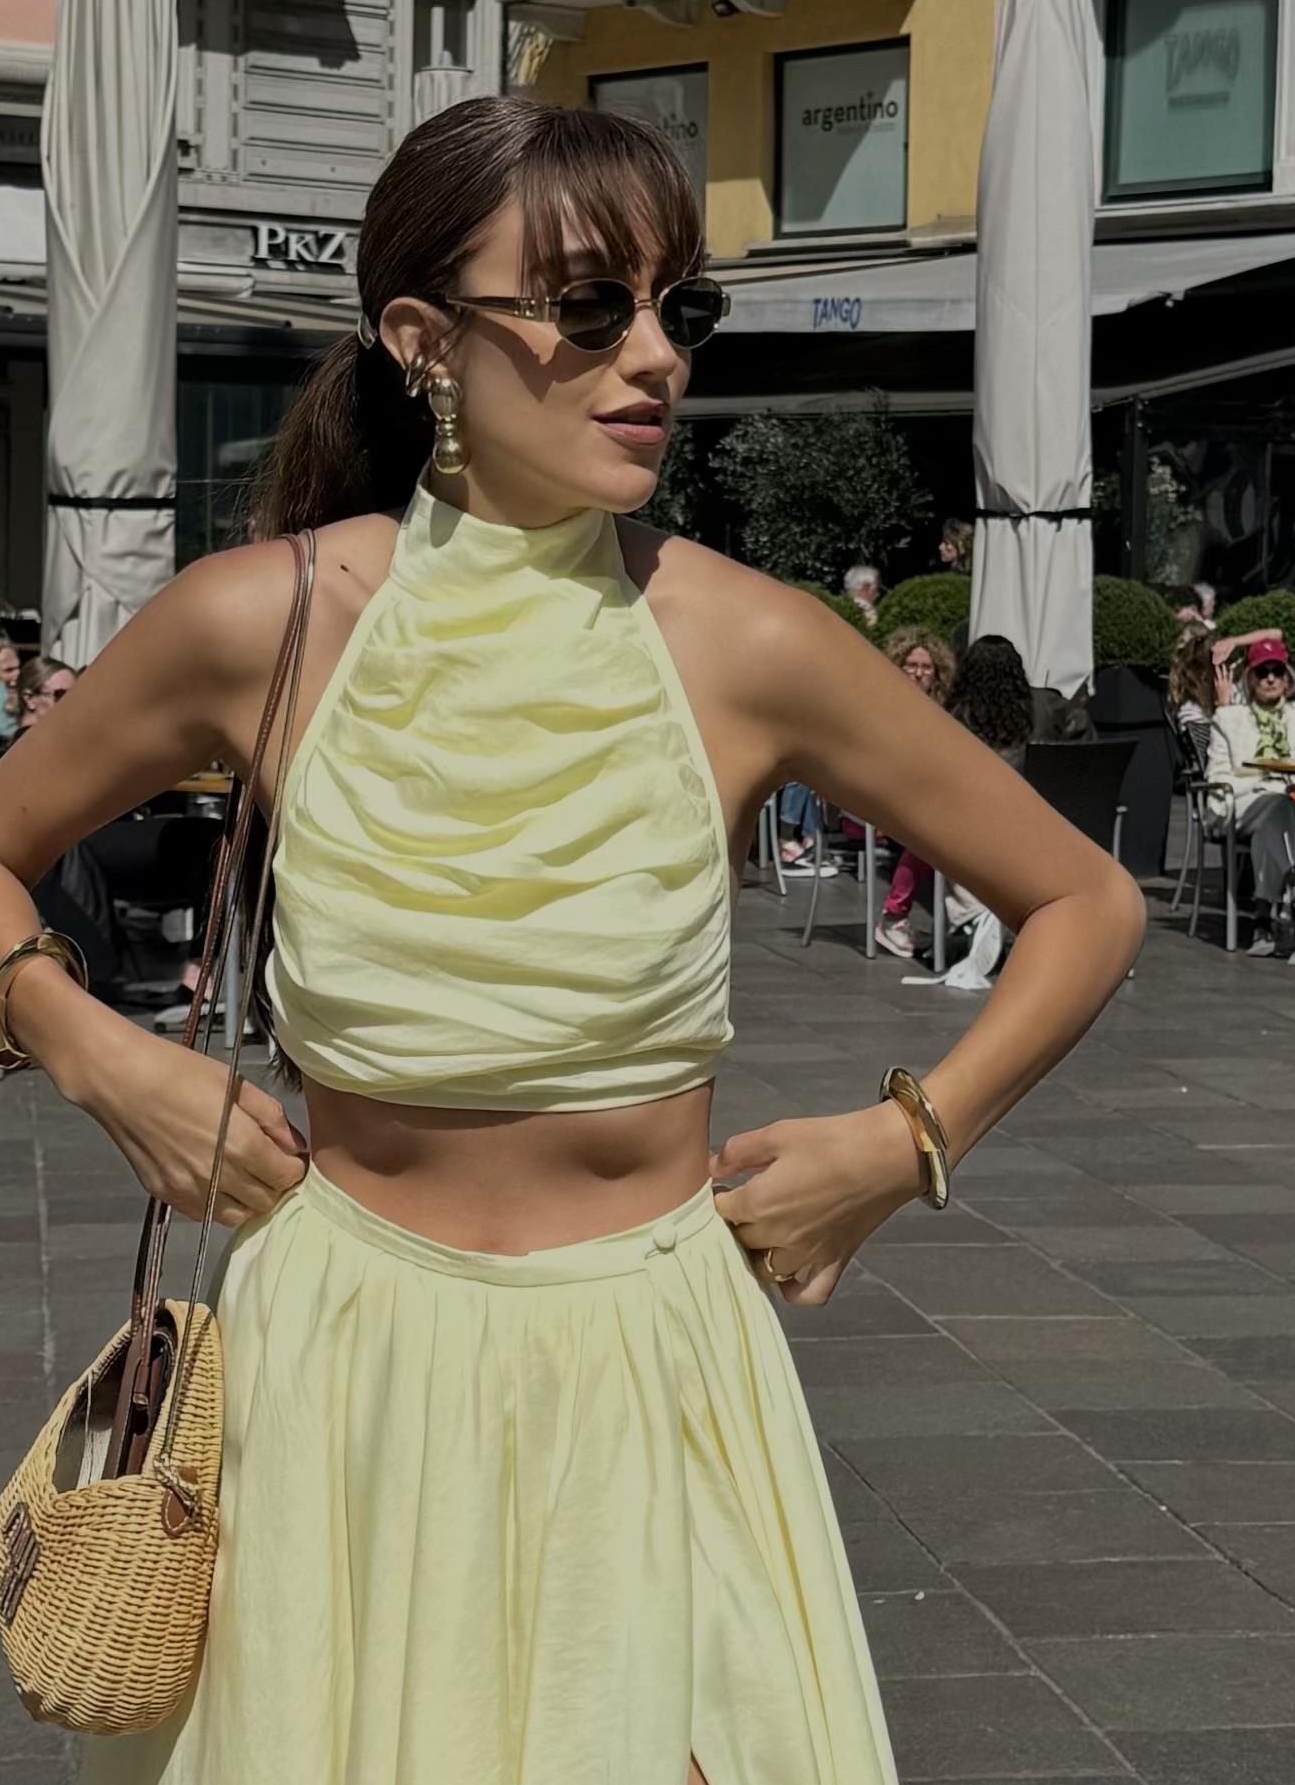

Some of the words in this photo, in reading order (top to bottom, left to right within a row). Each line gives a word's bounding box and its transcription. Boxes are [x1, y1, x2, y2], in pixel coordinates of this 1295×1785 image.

[802, 90, 898, 132] argentino
[253, 224, 346, 264] PKZ
[812, 297, 863, 330] TANGO
